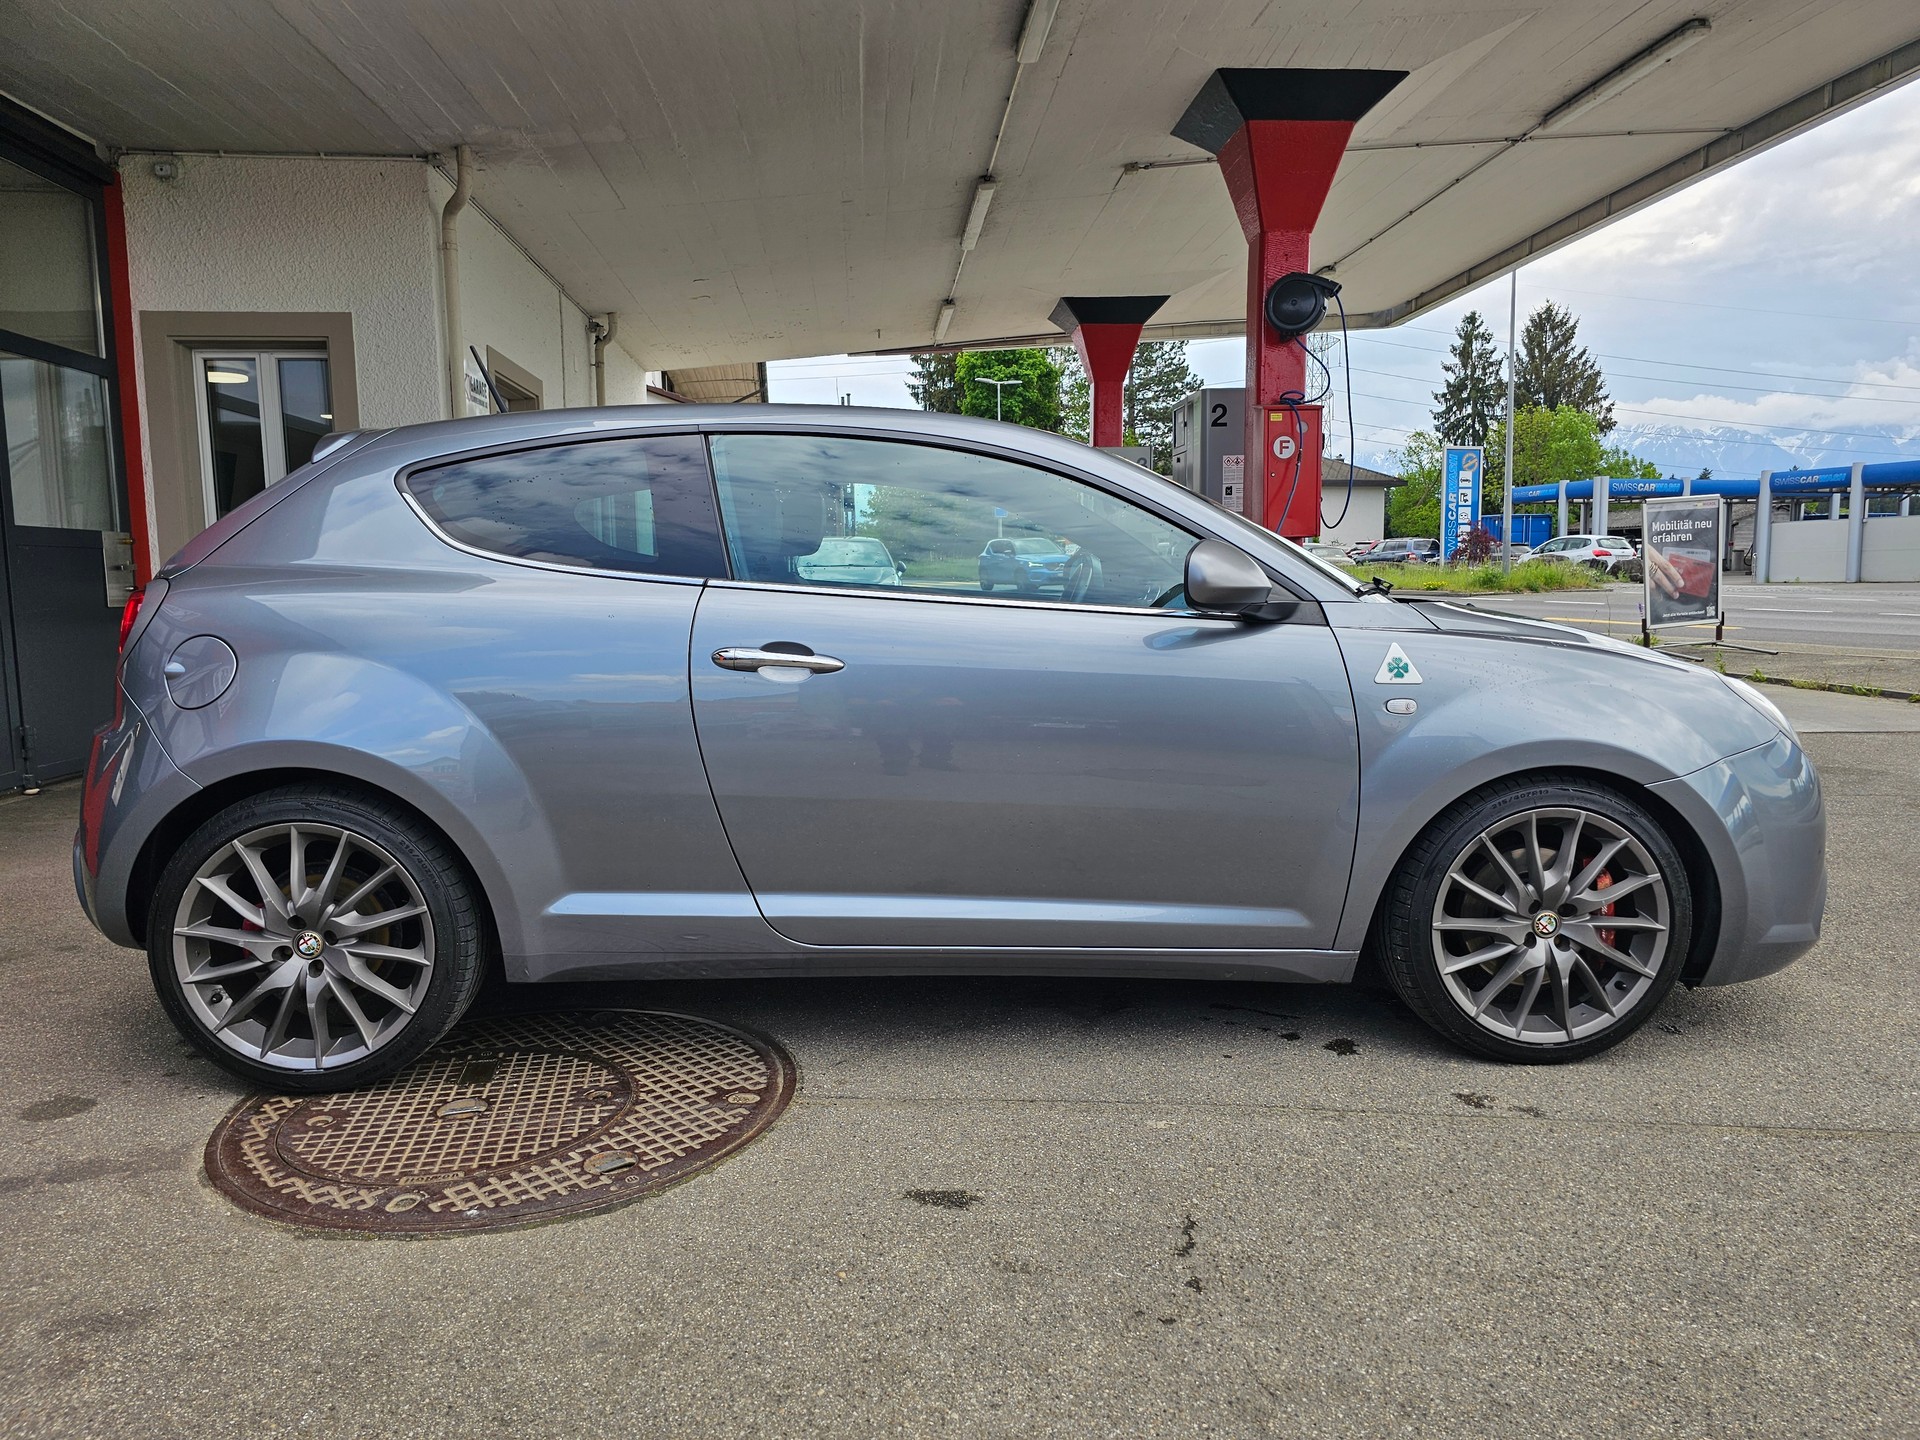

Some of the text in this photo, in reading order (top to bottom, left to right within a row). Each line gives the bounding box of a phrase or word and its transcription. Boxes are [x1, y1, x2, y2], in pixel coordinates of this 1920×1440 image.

[1210, 403, 1228, 427] 2
[1279, 440, 1291, 455] F
[1652, 519, 1712, 532] Mobilität neu
[1652, 532, 1693, 543] erfahren
